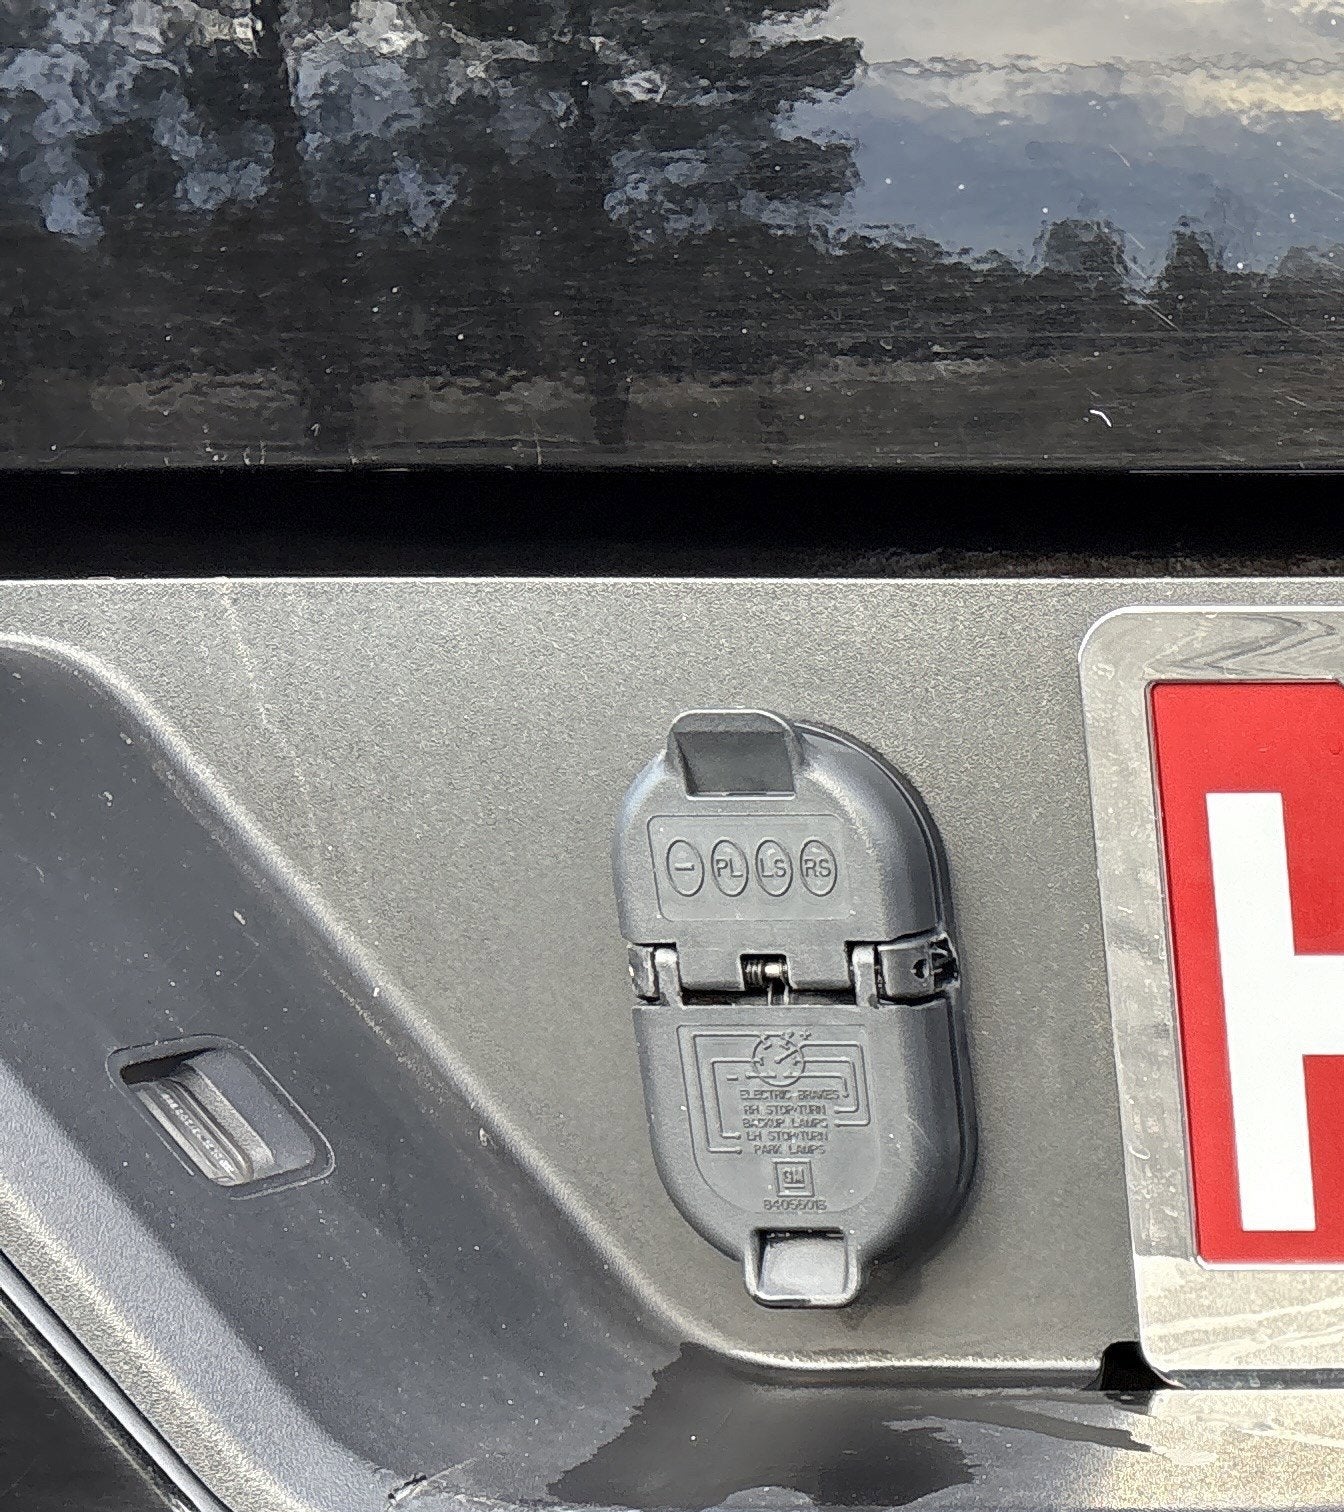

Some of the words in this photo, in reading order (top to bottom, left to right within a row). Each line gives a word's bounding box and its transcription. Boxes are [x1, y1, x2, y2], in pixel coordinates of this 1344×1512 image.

[715, 857, 744, 878] PL
[759, 857, 787, 878] LS
[804, 857, 832, 878] RS
[740, 1089, 792, 1100] ELECTRIC
[797, 1089, 840, 1100] BRAKES
